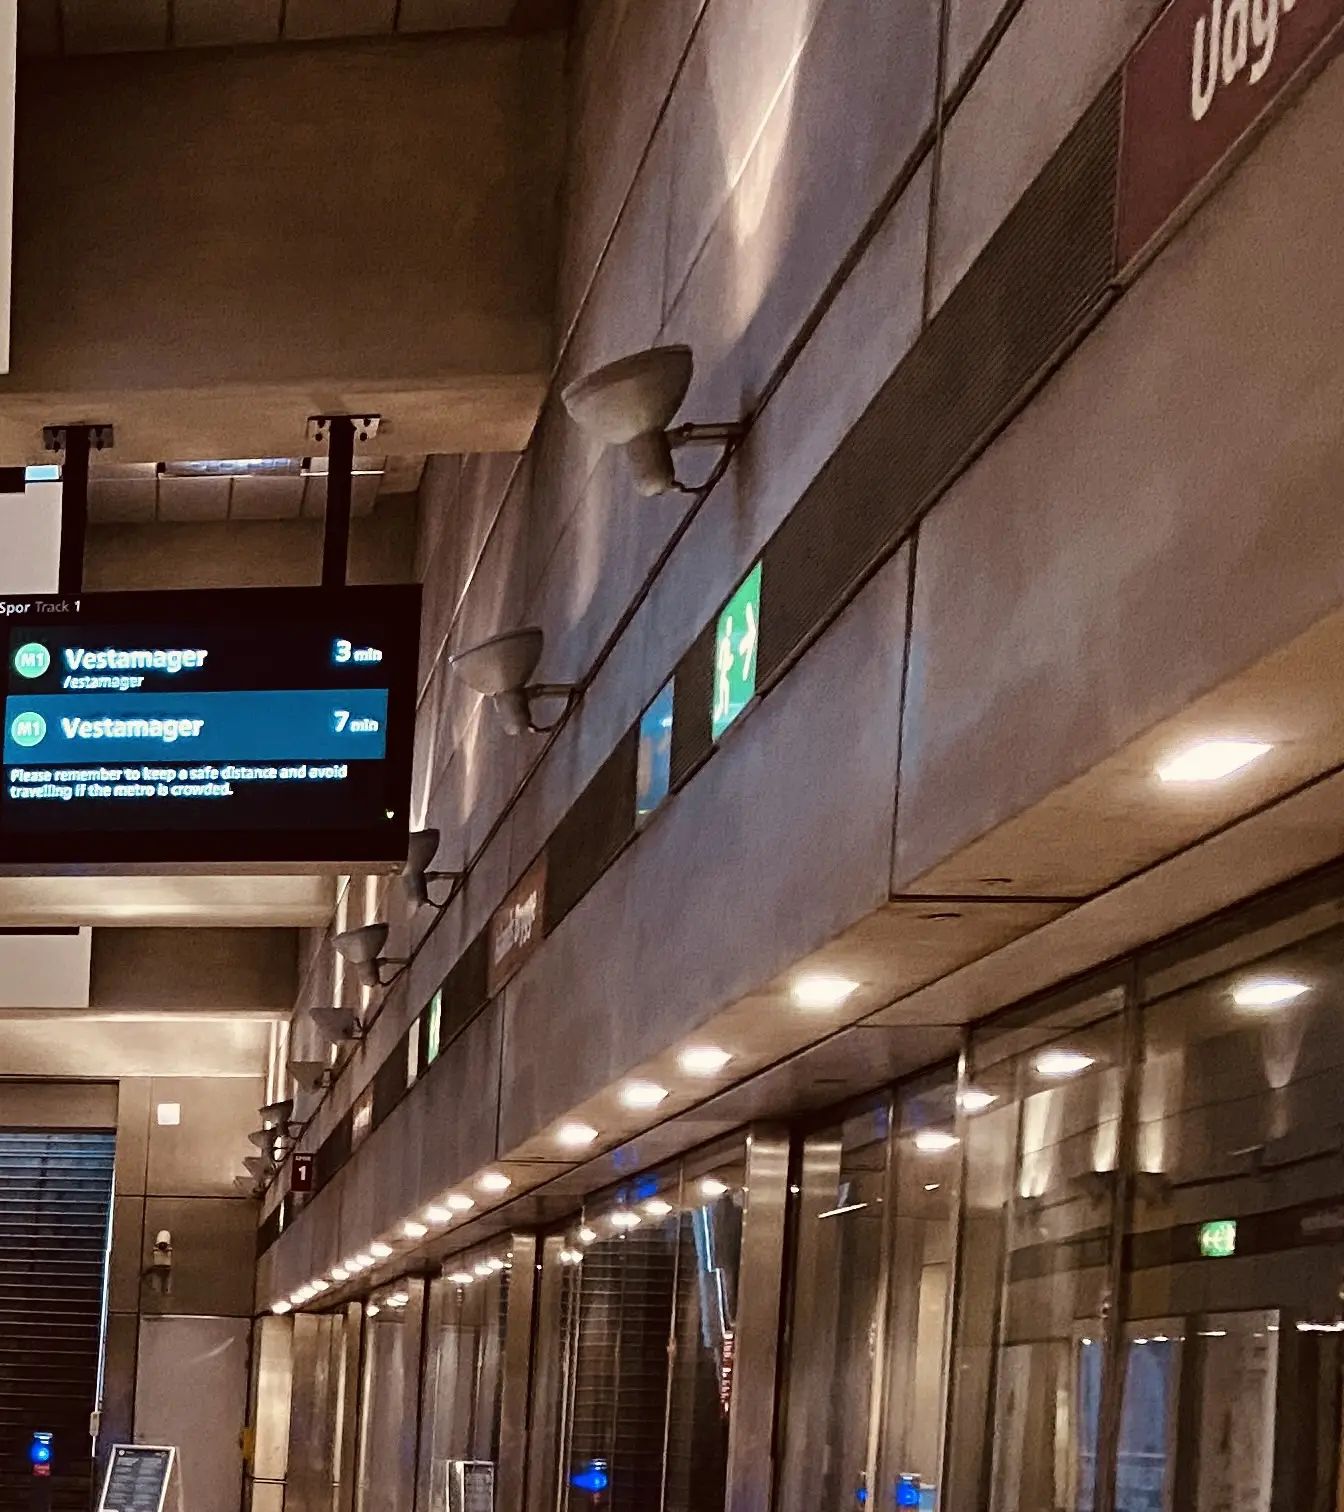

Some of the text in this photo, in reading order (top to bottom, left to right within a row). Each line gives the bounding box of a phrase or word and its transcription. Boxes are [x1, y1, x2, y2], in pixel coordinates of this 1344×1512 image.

[35, 601, 69, 613] Track
[74, 600, 81, 612] 1
[20, 639, 382, 673] M1 Vestamager 3 min
[16, 710, 379, 742] M1 Vestamager 7 min
[10, 764, 348, 782] Please remember to keep a safe distance and avoid
[10, 782, 234, 800] travelling if the metro is crowded.
[298, 1166, 306, 1180] 1
